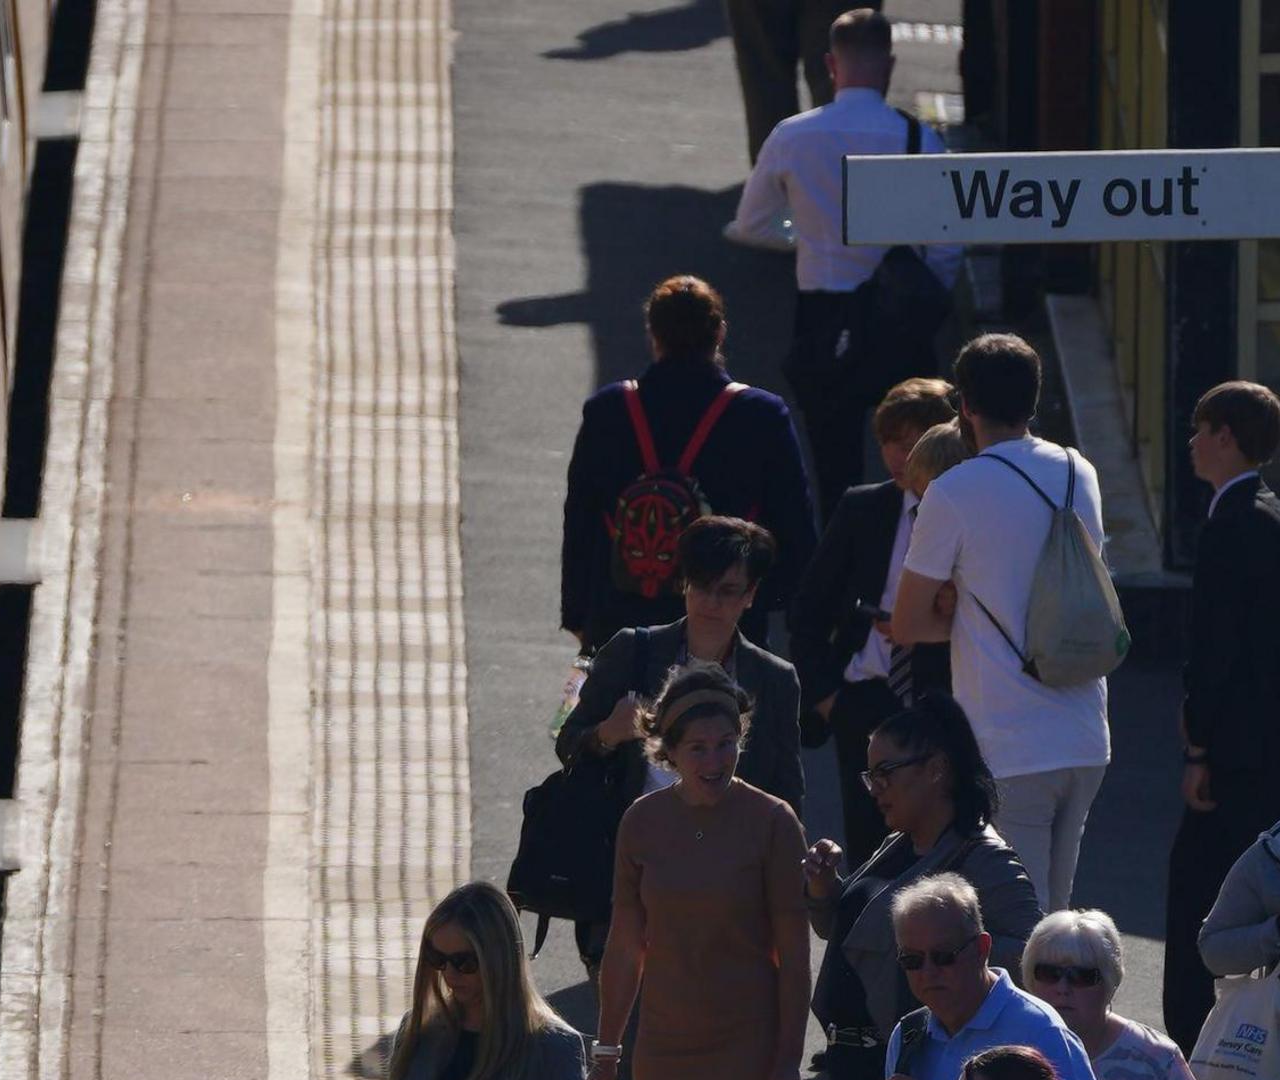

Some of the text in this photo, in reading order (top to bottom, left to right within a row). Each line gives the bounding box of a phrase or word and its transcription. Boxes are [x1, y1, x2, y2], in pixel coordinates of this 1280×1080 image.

[950, 166, 1200, 228] Way out
[1237, 1024, 1268, 1044] NHS
